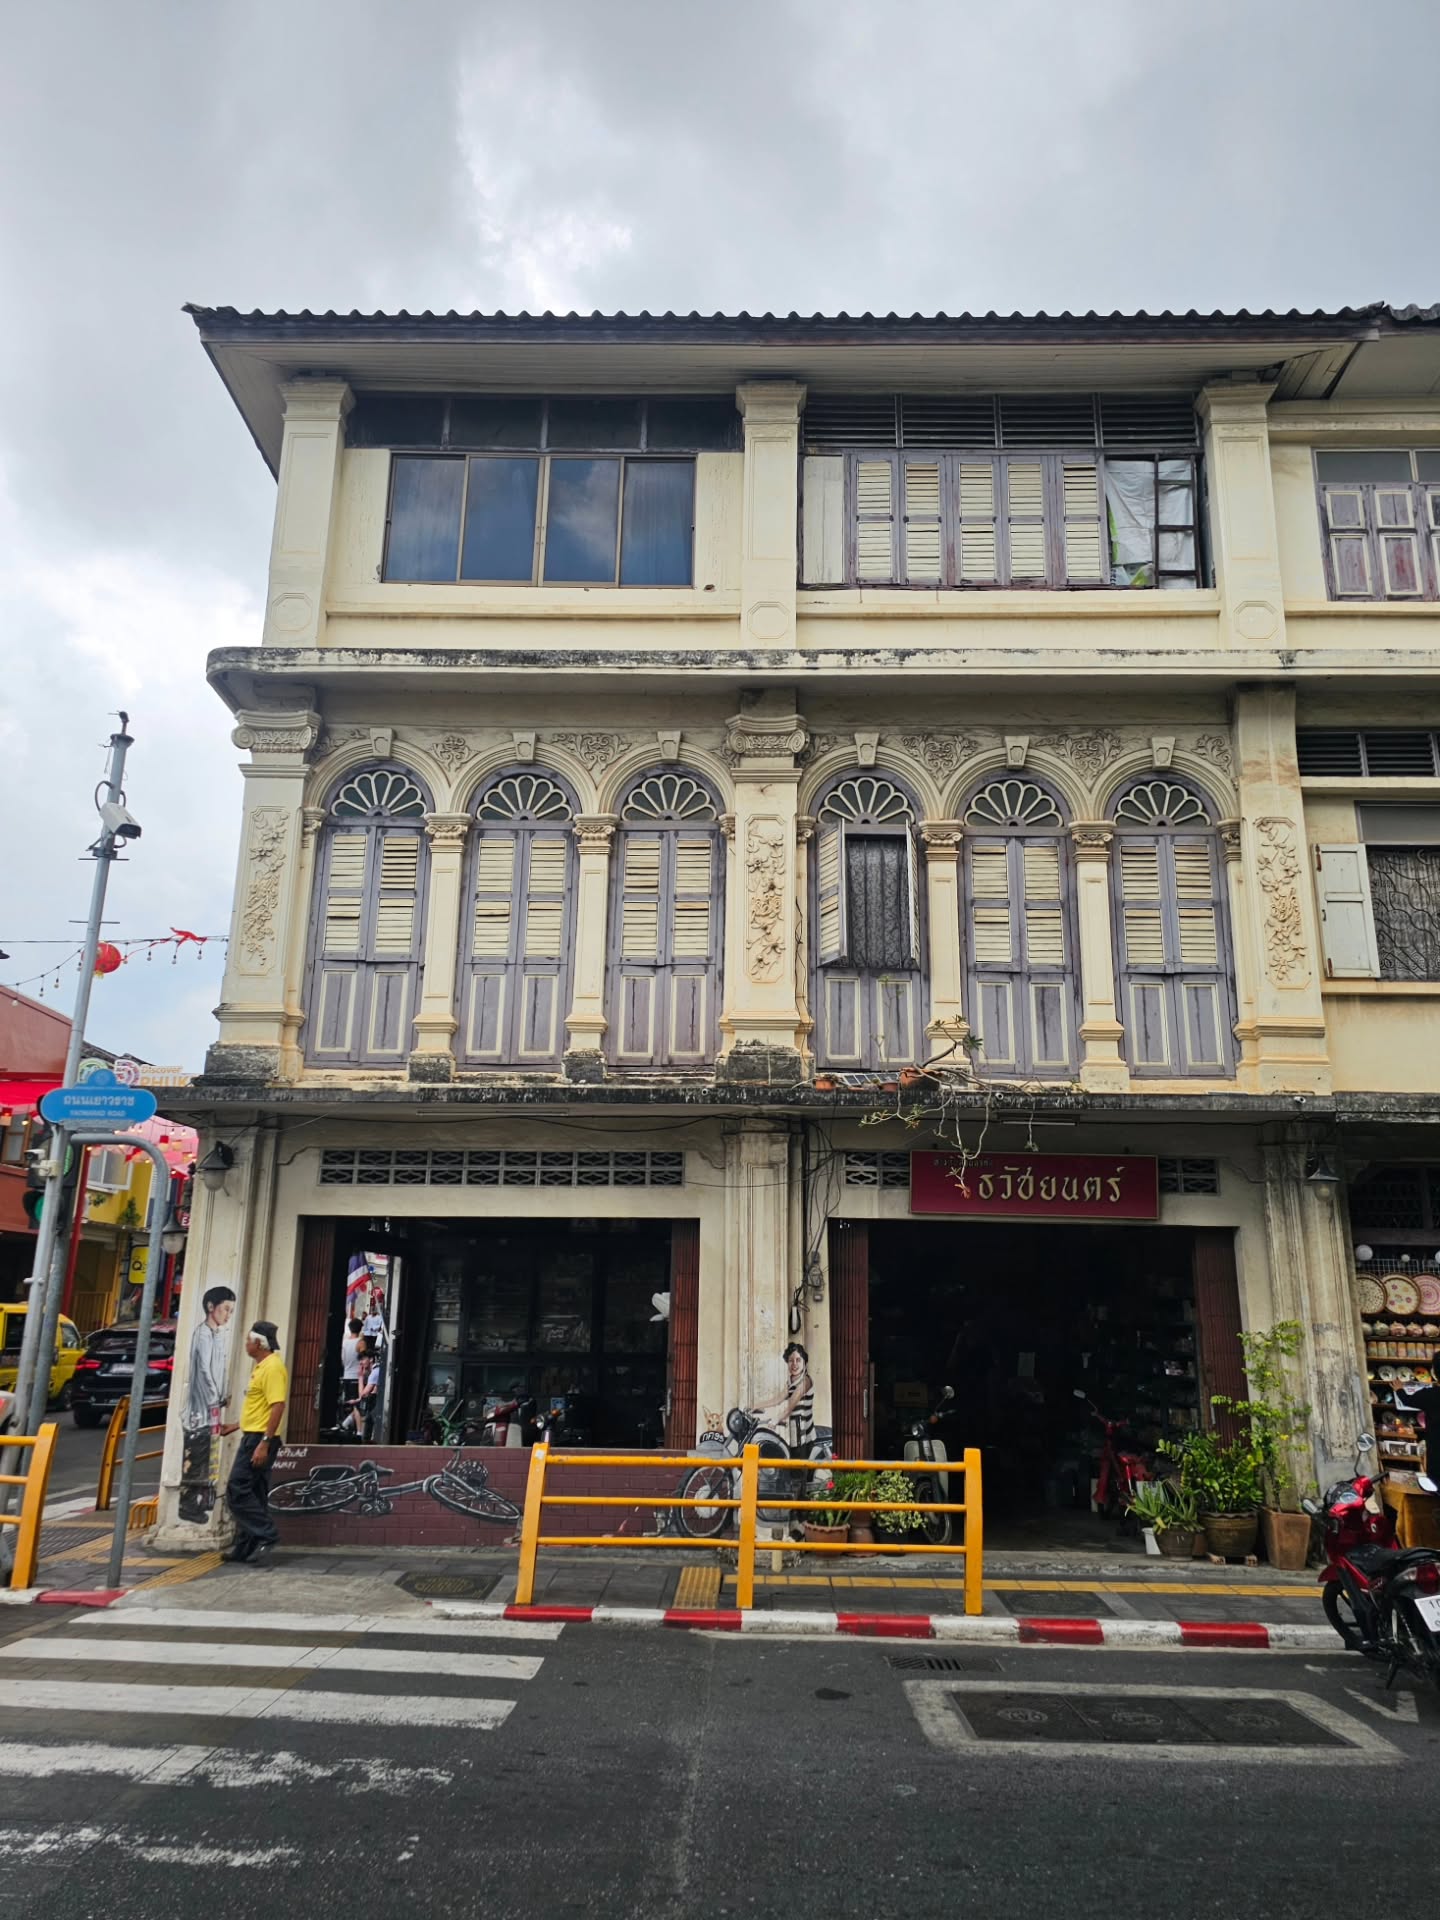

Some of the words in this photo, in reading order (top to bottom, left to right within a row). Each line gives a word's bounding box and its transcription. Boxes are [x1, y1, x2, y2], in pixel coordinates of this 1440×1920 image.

[107, 1109, 126, 1117] ROAD
[977, 1165, 1127, 1203] ธวัชยนตร์
